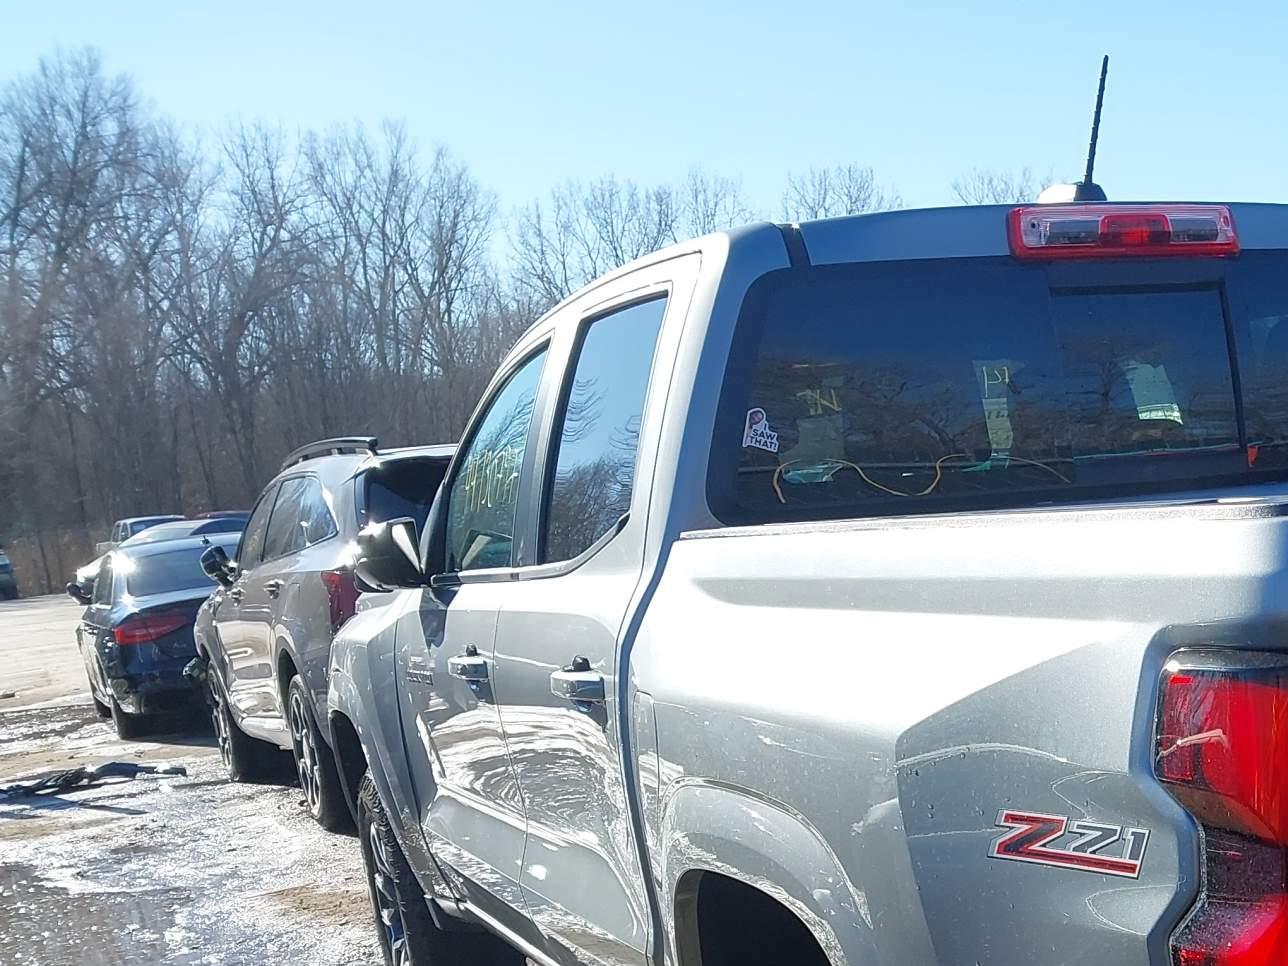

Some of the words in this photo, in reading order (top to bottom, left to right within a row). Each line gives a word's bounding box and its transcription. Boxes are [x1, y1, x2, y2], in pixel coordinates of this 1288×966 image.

[752, 429, 776, 441] SAW
[750, 437, 777, 450] THAT!
[987, 808, 1151, 881] Z71
